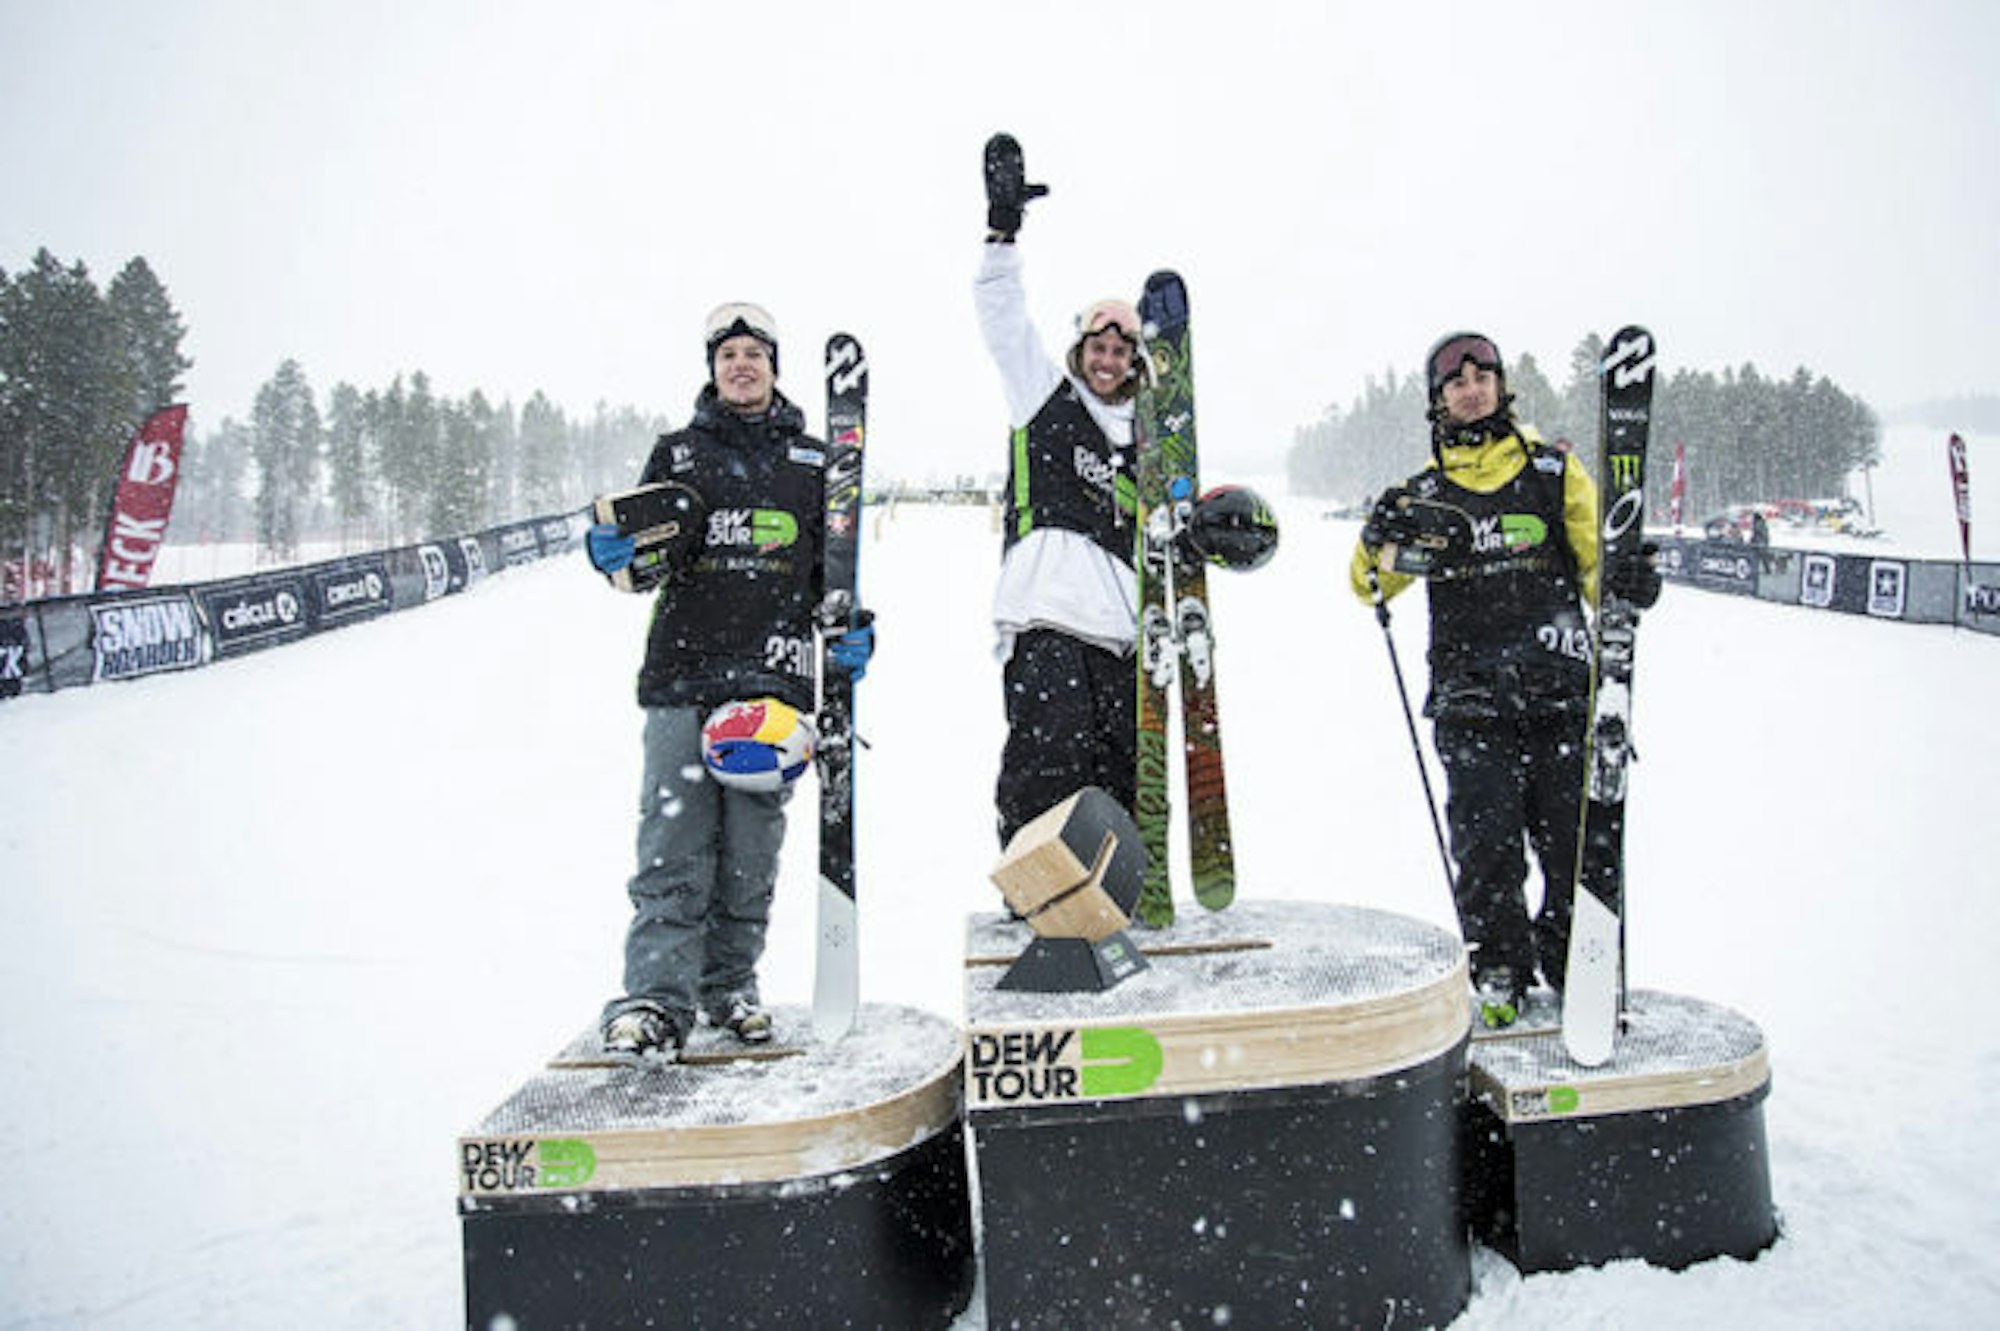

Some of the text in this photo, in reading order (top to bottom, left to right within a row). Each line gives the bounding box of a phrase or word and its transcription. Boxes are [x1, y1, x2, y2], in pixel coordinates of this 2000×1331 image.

[708, 508, 752, 530] EW
[705, 527, 752, 546] OUR
[101, 602, 195, 654] SNOW
[970, 1029, 1075, 1068] DEW
[972, 1066, 1078, 1101] TOUR
[463, 1140, 535, 1166] DEW
[464, 1164, 536, 1191] TOUR
